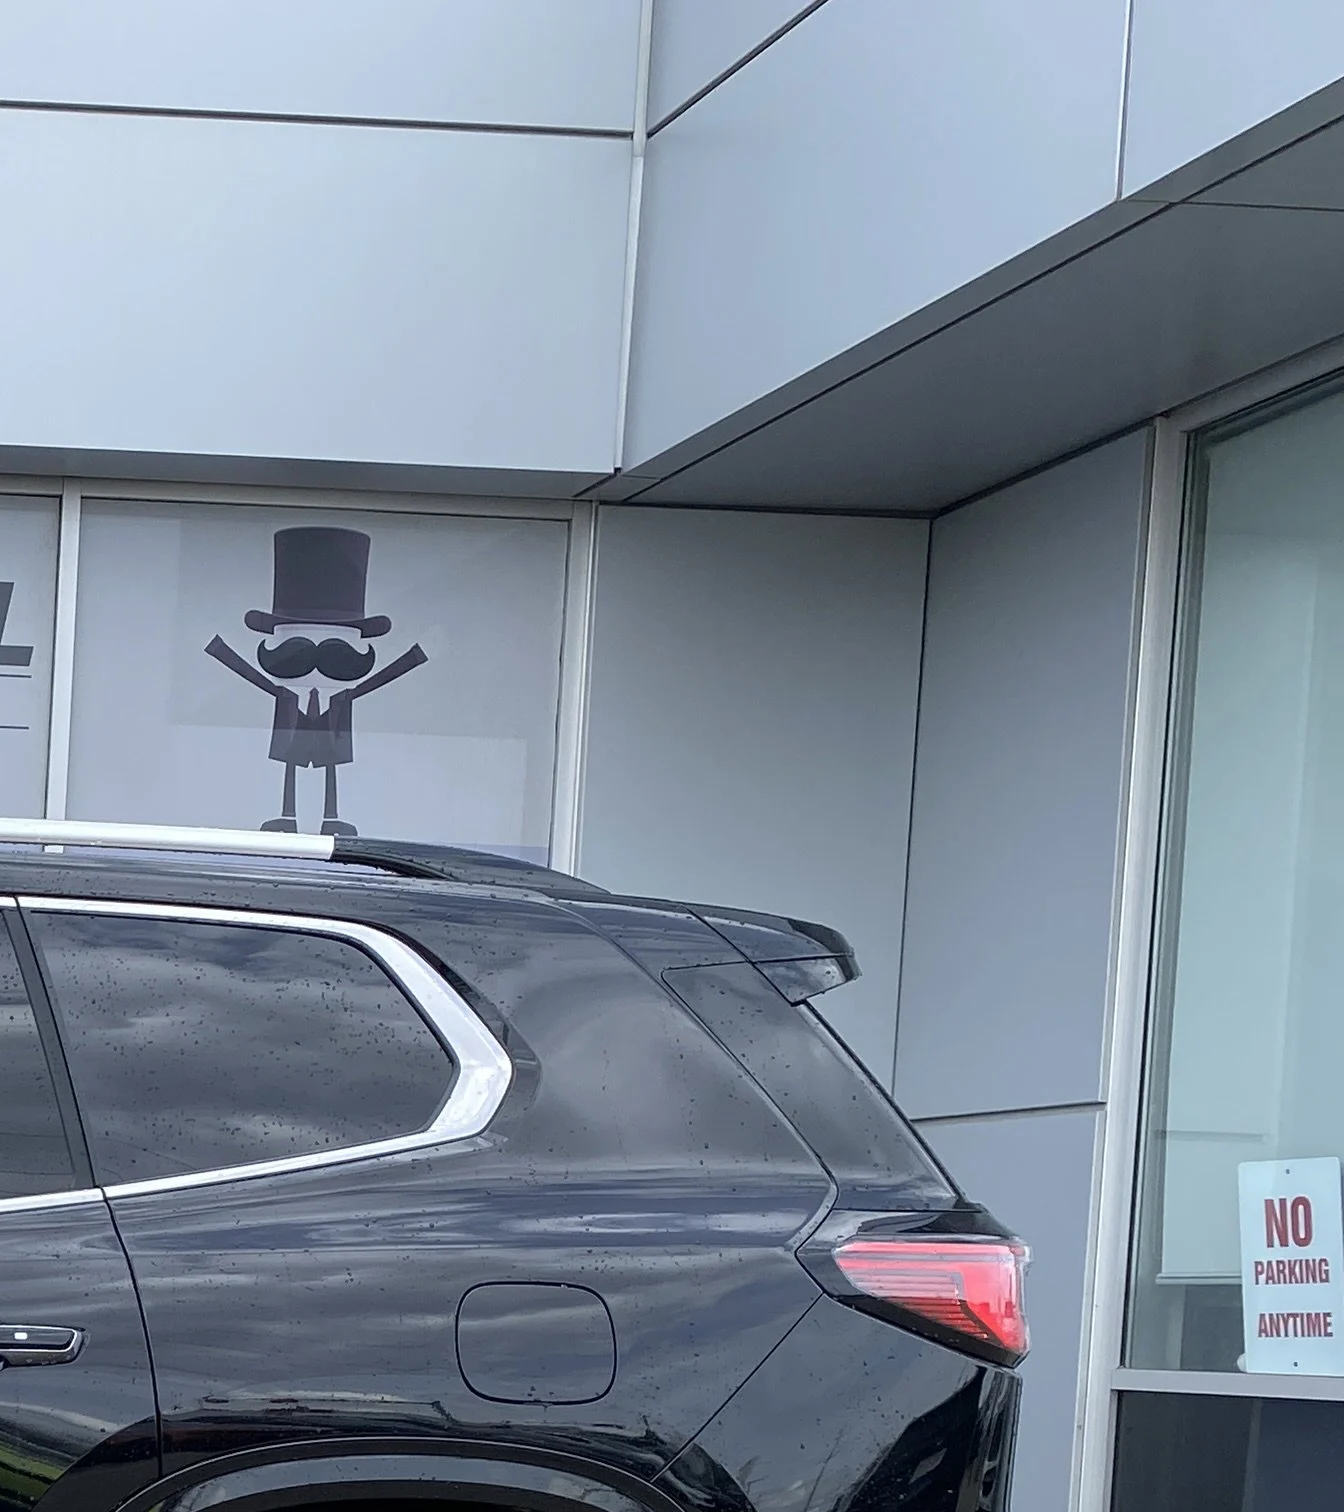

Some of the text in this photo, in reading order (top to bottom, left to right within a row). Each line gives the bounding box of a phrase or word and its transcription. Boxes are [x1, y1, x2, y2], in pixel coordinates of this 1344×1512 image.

[1264, 1196, 1313, 1248] NO
[1254, 1258, 1330, 1286] PARKING
[1257, 1312, 1334, 1338] ANYTIME
